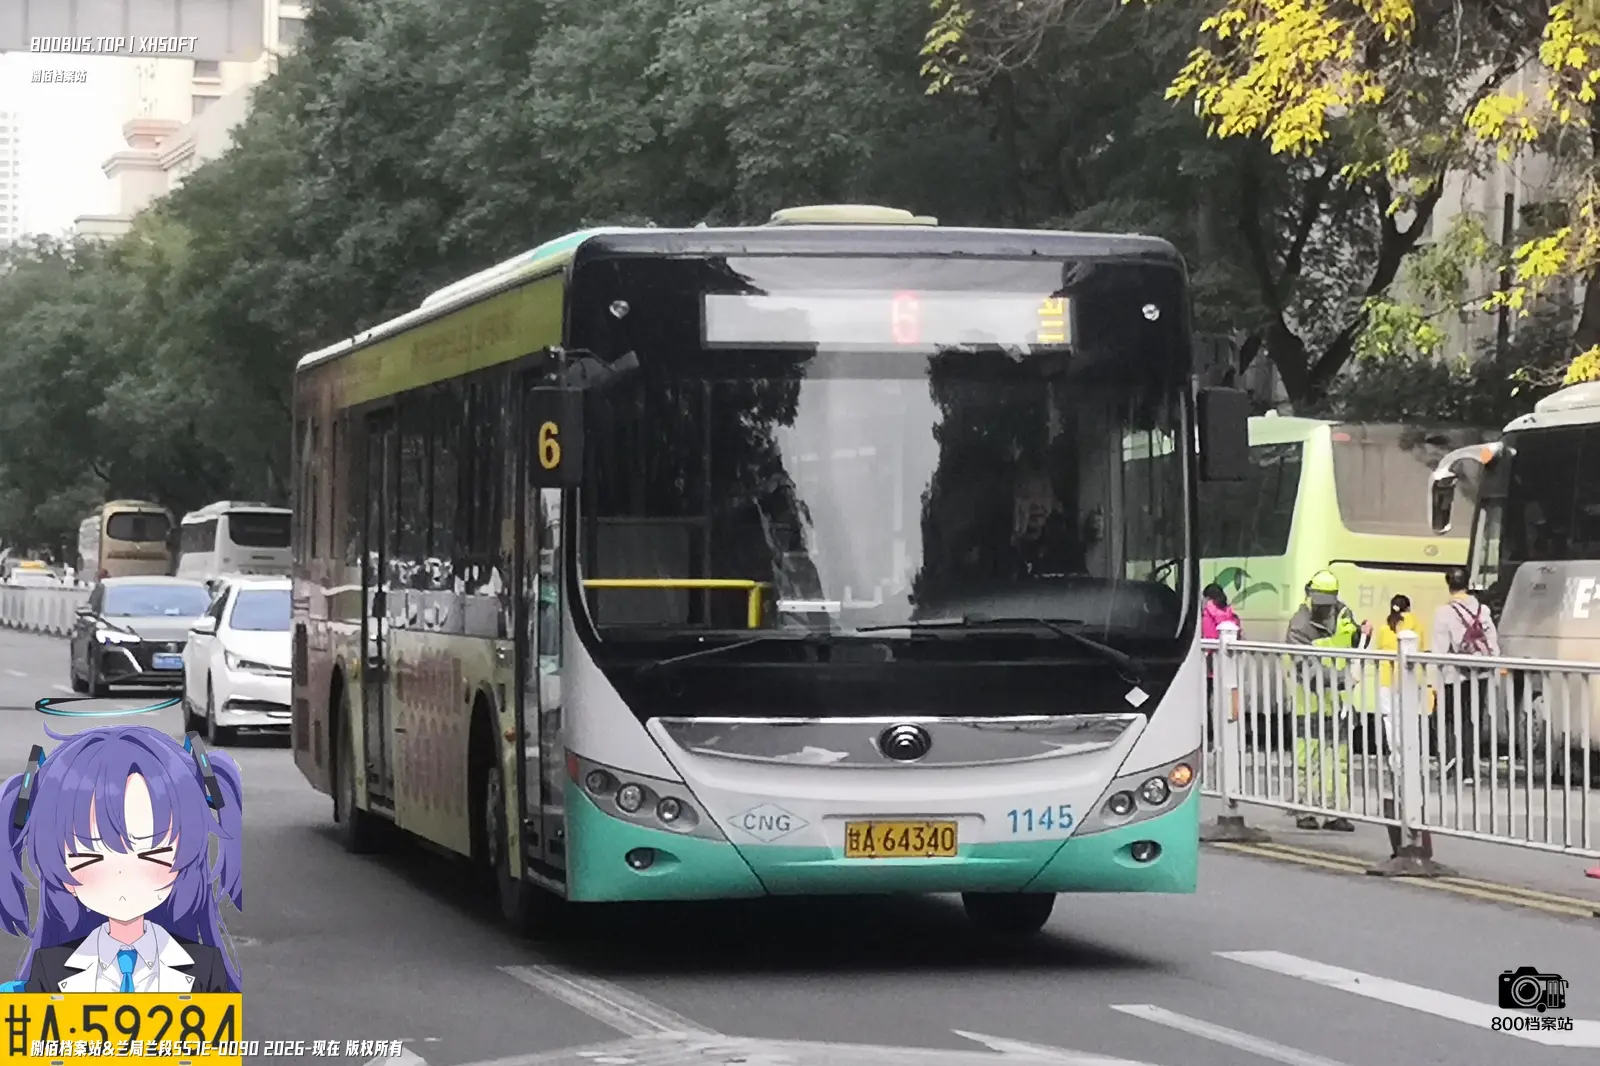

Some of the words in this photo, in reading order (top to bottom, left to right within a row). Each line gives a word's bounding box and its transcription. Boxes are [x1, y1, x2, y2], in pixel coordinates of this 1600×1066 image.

[538, 421, 561, 469] 6
[743, 813, 791, 832] CNG
[1007, 804, 1074, 834] 1145
